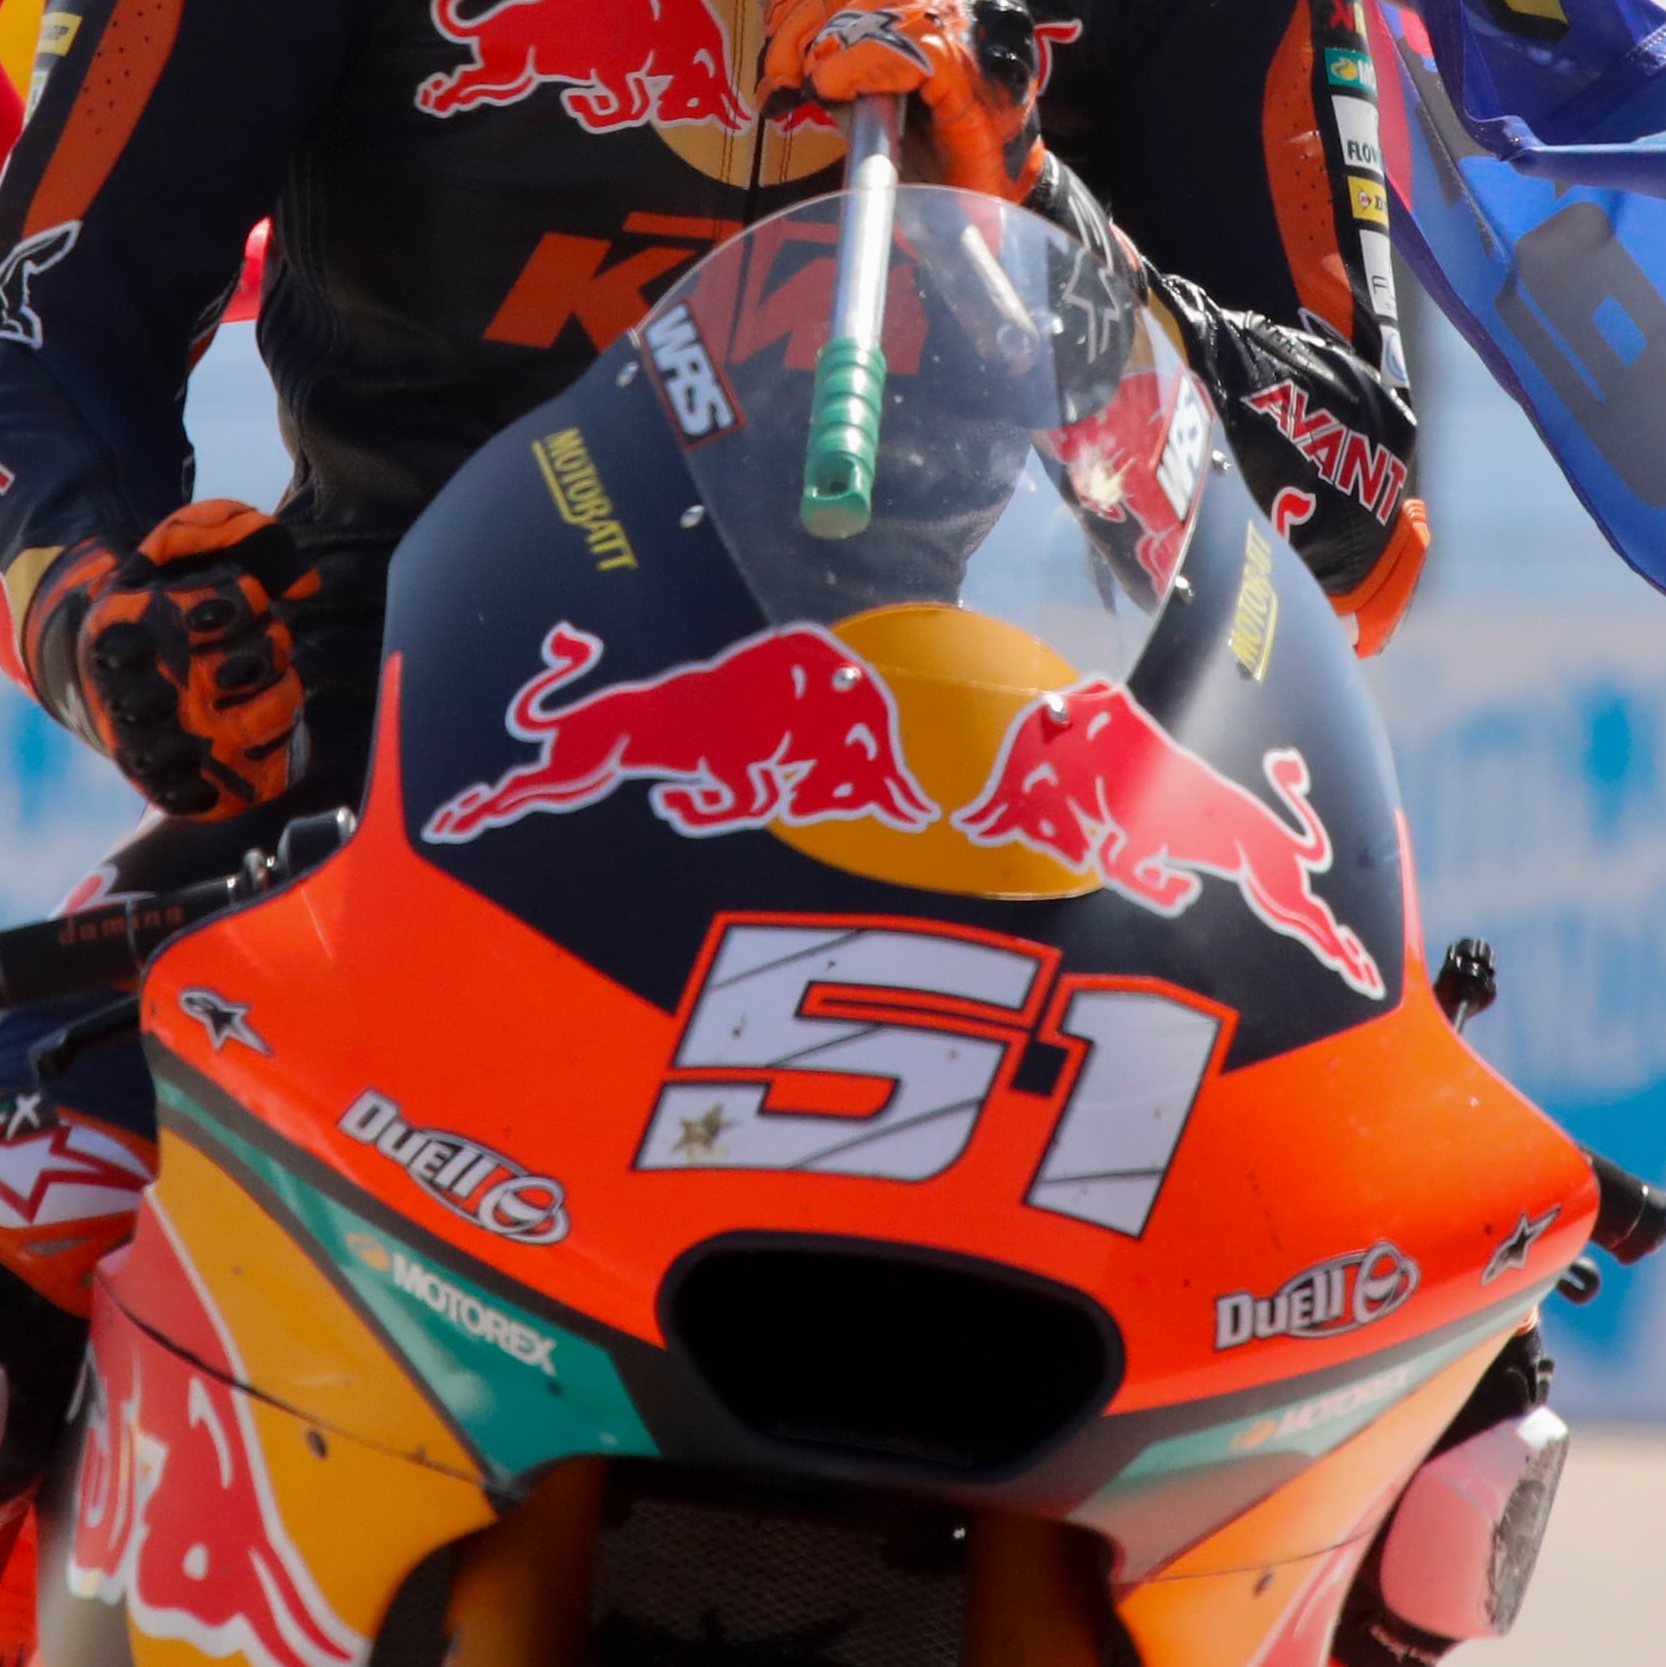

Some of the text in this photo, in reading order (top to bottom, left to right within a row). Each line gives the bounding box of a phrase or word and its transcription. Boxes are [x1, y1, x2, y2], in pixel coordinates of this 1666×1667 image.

[483, 211, 928, 376] KTM
[644, 304, 733, 437] WRS
[1239, 379, 1408, 526] AVANT
[633, 922, 1225, 1239] 51
[391, 1252, 559, 1376] MOTOREX
